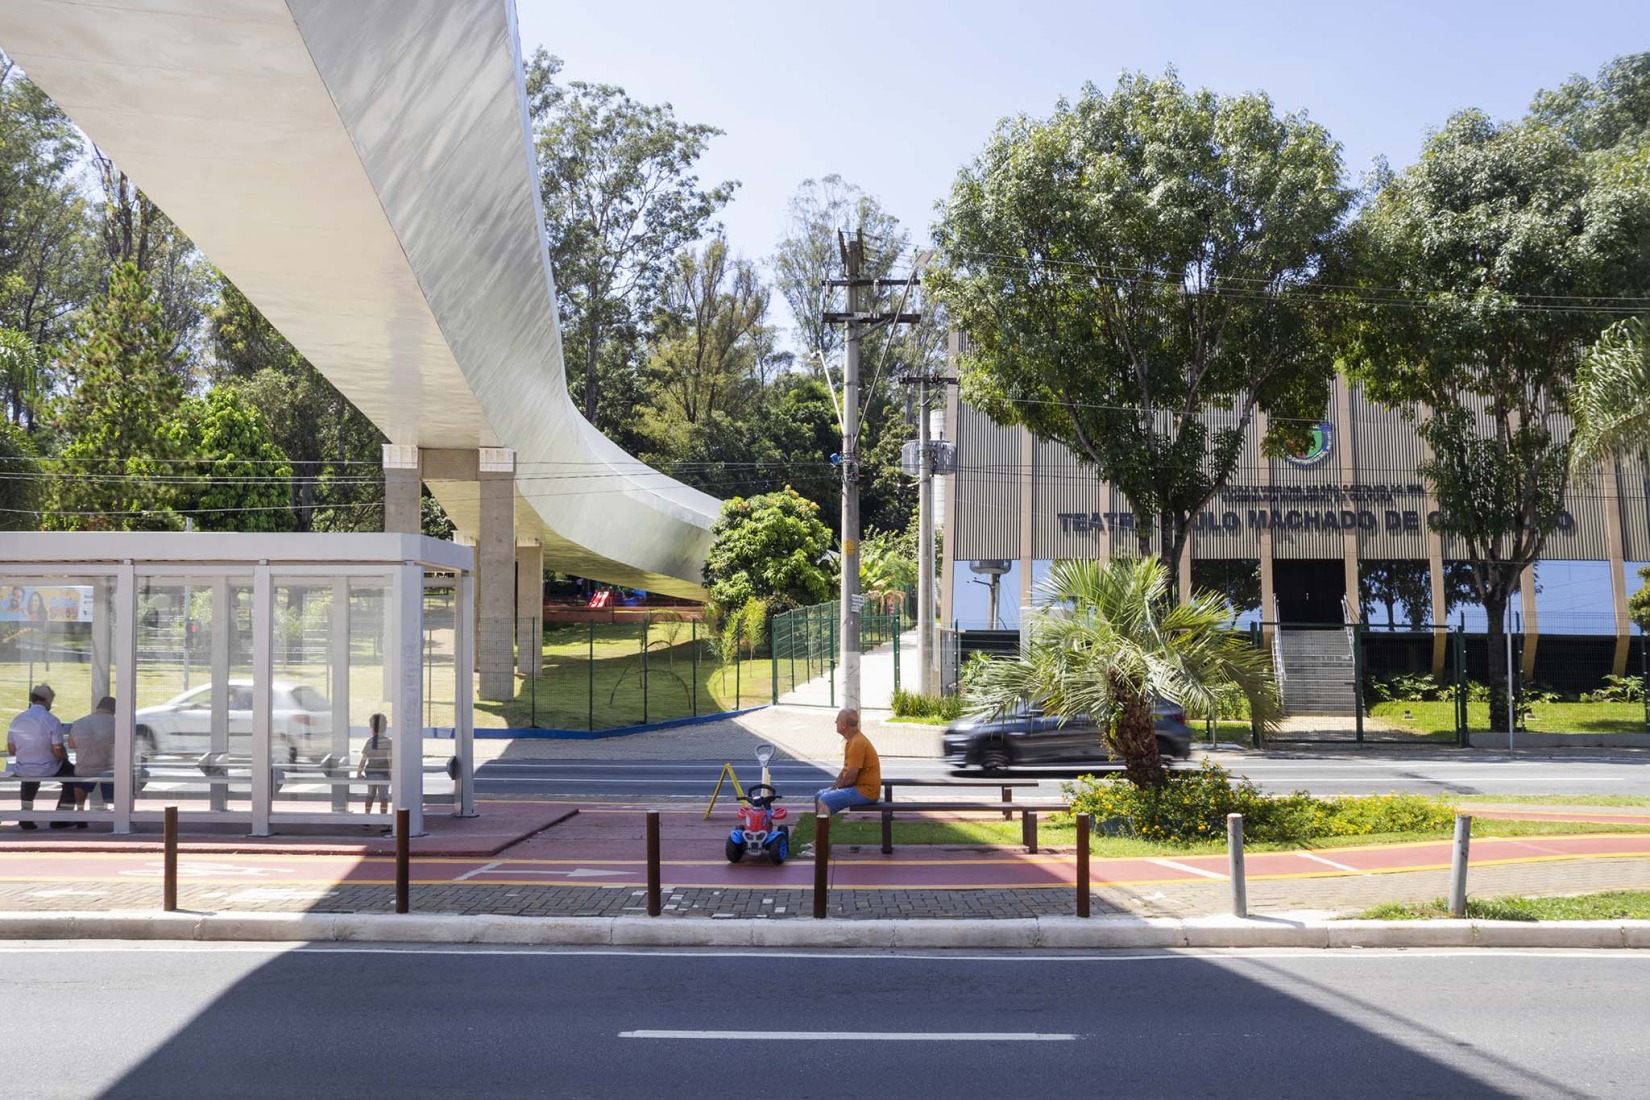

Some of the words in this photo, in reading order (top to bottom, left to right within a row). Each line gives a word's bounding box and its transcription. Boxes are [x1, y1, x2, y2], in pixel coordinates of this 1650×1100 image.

[1057, 512, 1146, 532] TEATR
[1249, 510, 1377, 530] MACHADO
[1386, 510, 1419, 530] DE
